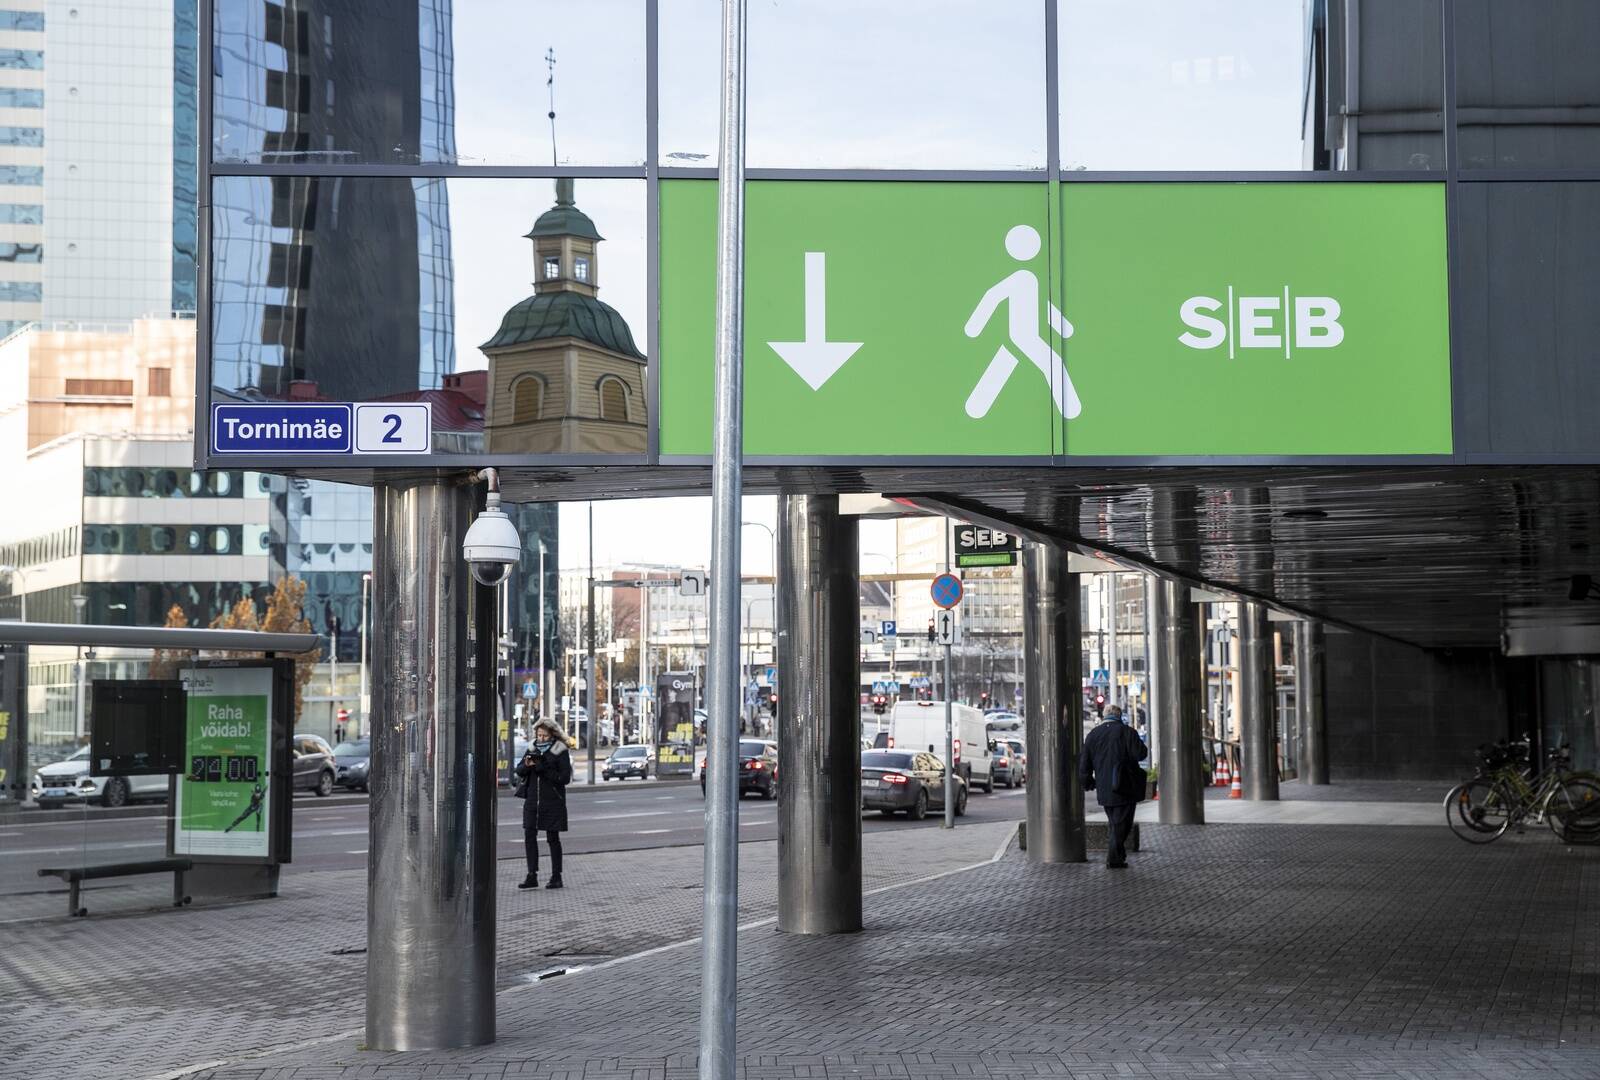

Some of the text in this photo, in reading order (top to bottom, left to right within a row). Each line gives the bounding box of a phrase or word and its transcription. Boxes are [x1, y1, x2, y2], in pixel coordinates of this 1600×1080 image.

[1178, 288, 1345, 358] SEB
[223, 413, 403, 444] Tornimäe 2
[960, 528, 1008, 548] SEB
[884, 622, 894, 635] P
[208, 704, 243, 720] Raha
[200, 721, 251, 737] võidab!
